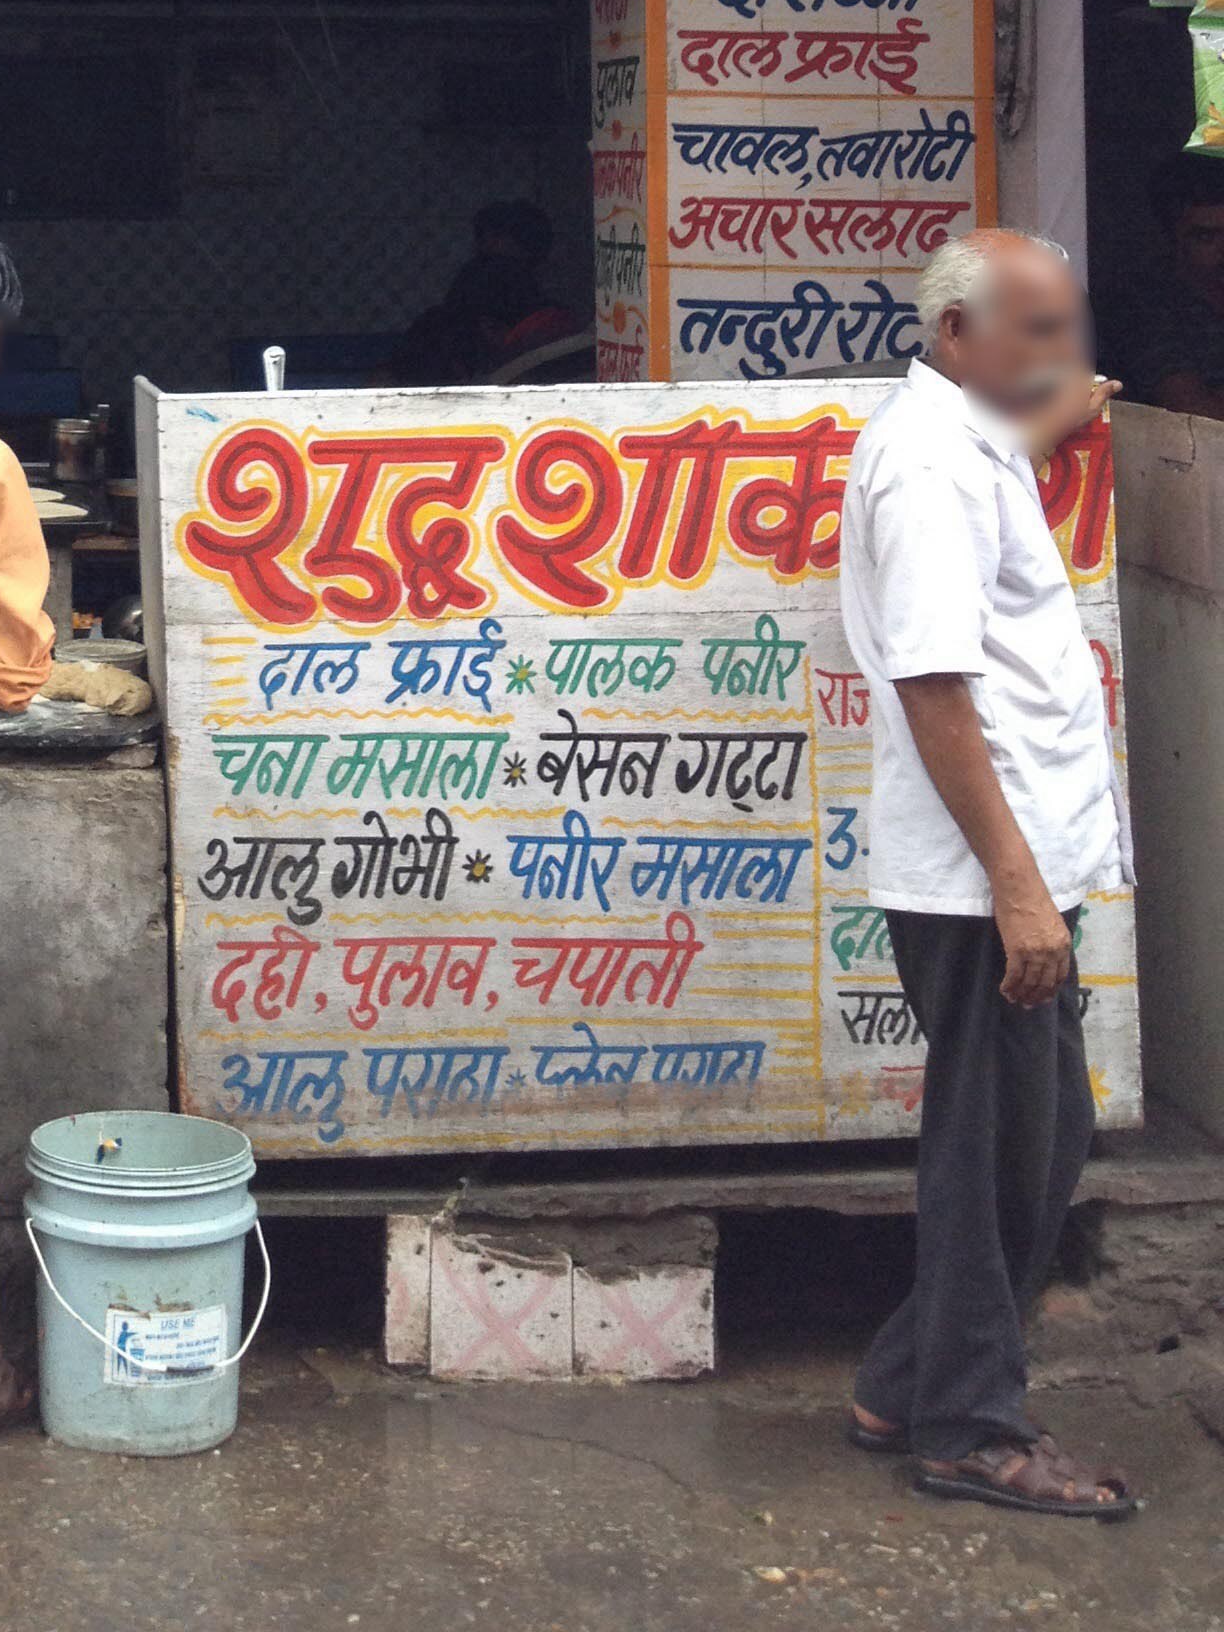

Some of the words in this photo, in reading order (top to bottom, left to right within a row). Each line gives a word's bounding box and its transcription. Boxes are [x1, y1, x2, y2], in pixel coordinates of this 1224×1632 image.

[676, 28, 790, 87] दाल
[784, 17, 931, 95] फ्राई
[816, 128, 904, 182] तवा
[893, 107, 977, 183] रोटी
[669, 195, 804, 259] अचार
[838, 278, 928, 362] रोट
[182, 426, 506, 625] शुद्ध
[256, 640, 373, 710] दाल
[386, 617, 508, 712] फ्राई
[544, 637, 684, 699] पालक
[700, 613, 808, 703] पनीर
[211, 732, 328, 800] चना
[325, 732, 511, 801] मसाला
[536, 707, 672, 802] बेसन
[198, 834, 325, 926] आलु
[330, 809, 461, 902] गोभी
[505, 809, 628, 913] पनीर
[629, 835, 814, 905] मसाला
[509, 910, 706, 1010] चपाती
[216, 1048, 350, 1143] आलु
